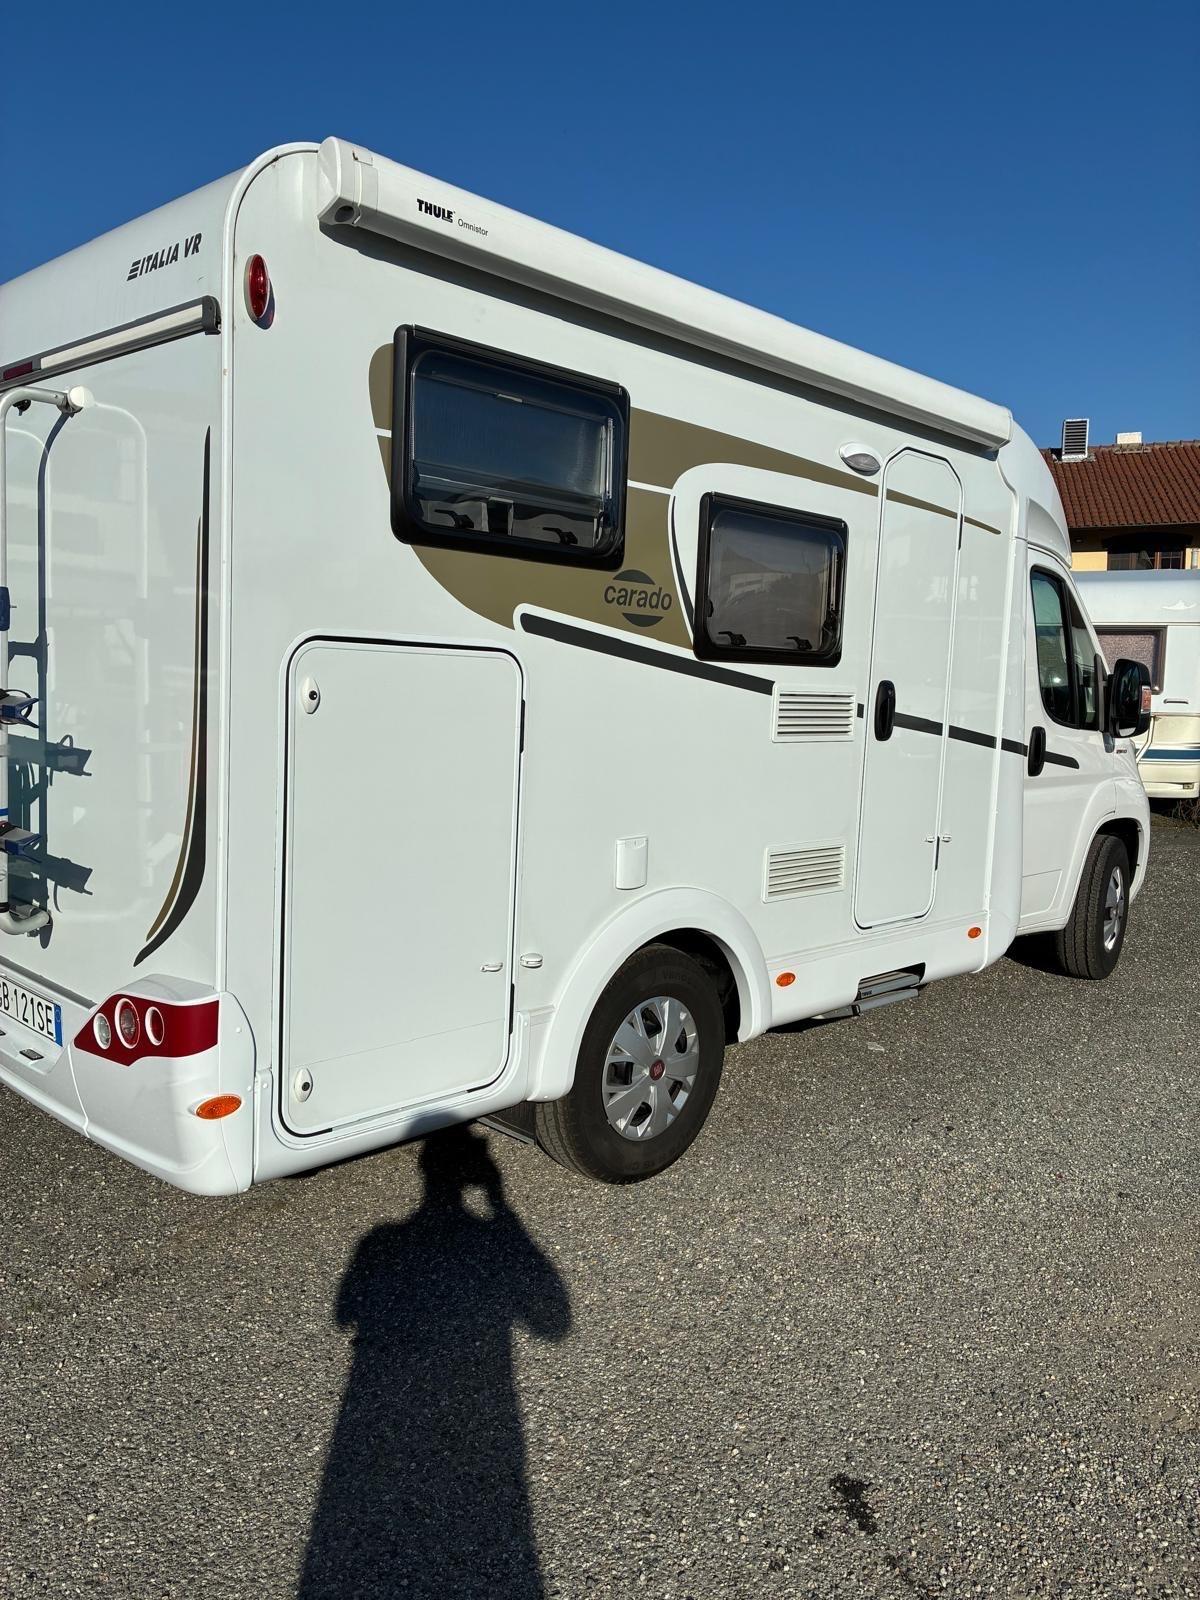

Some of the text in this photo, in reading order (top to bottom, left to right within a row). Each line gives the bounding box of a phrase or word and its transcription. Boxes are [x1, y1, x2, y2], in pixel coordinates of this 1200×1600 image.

[416, 198, 489, 237] THULE Omnistor
[184, 232, 203, 258] VR
[604, 585, 673, 611] carado
[13, 988, 54, 1037] 121SE
